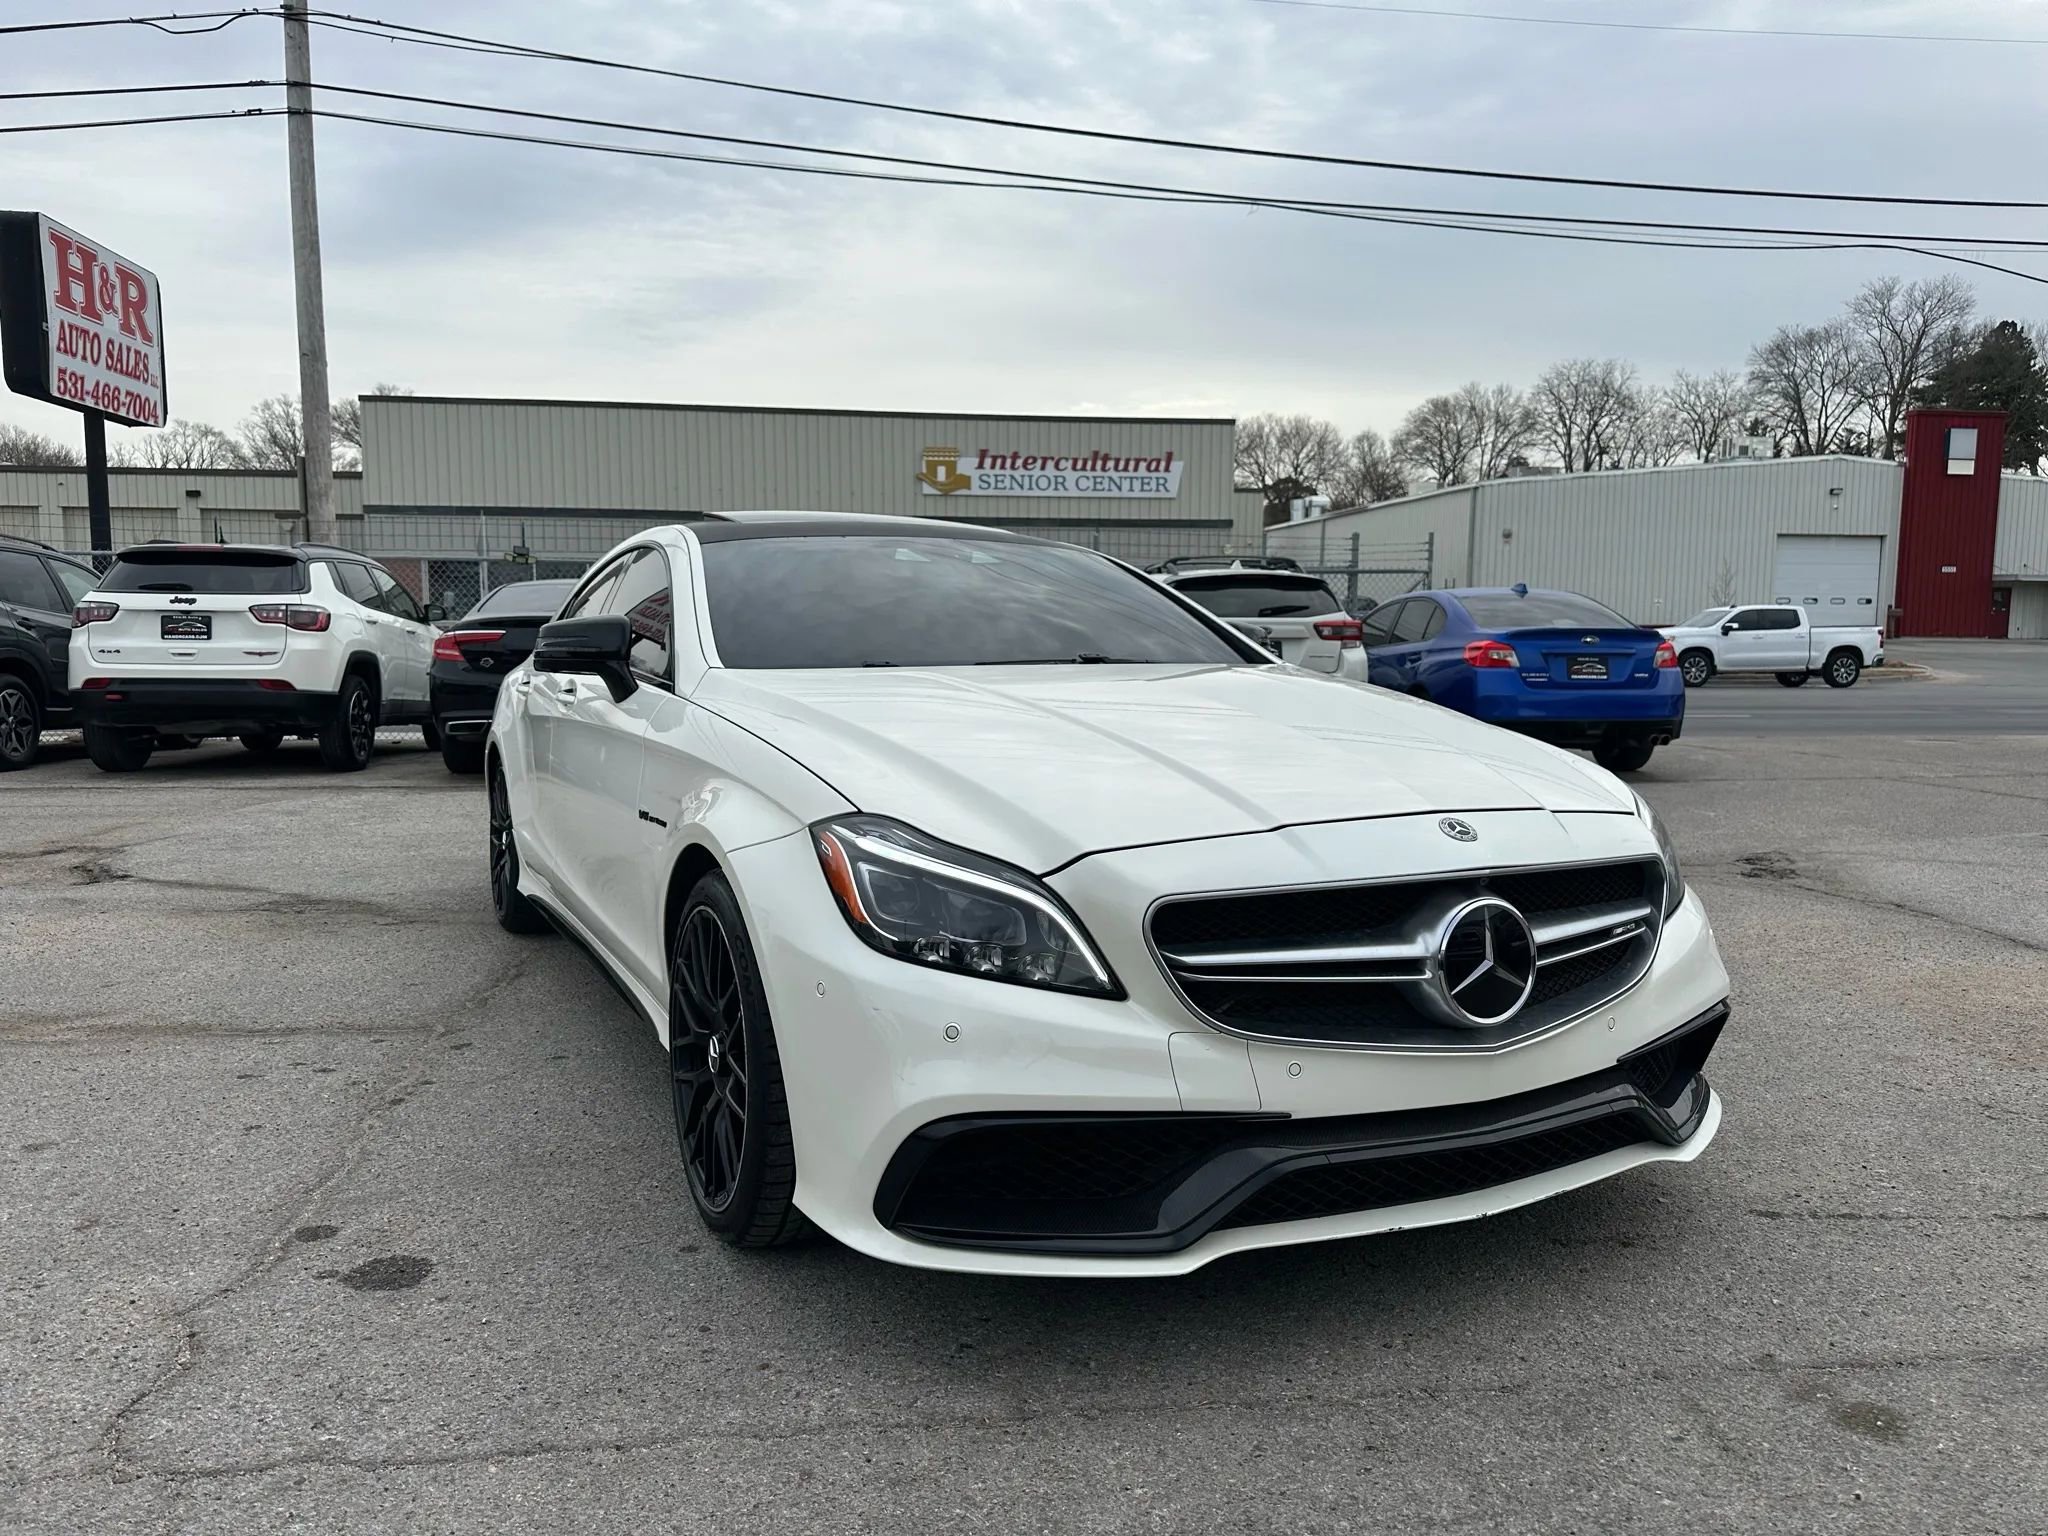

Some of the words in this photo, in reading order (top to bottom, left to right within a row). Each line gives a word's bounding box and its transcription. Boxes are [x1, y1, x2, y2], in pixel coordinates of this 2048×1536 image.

[49, 227, 154, 346] H&R
[56, 318, 101, 368] AUTO
[105, 336, 149, 385] SALES
[56, 366, 159, 425] 531-466-7004
[975, 449, 1174, 473] Intercultural
[978, 473, 1069, 491] SENIOR
[1075, 474, 1170, 493] CENTER
[169, 595, 197, 605] Jeep
